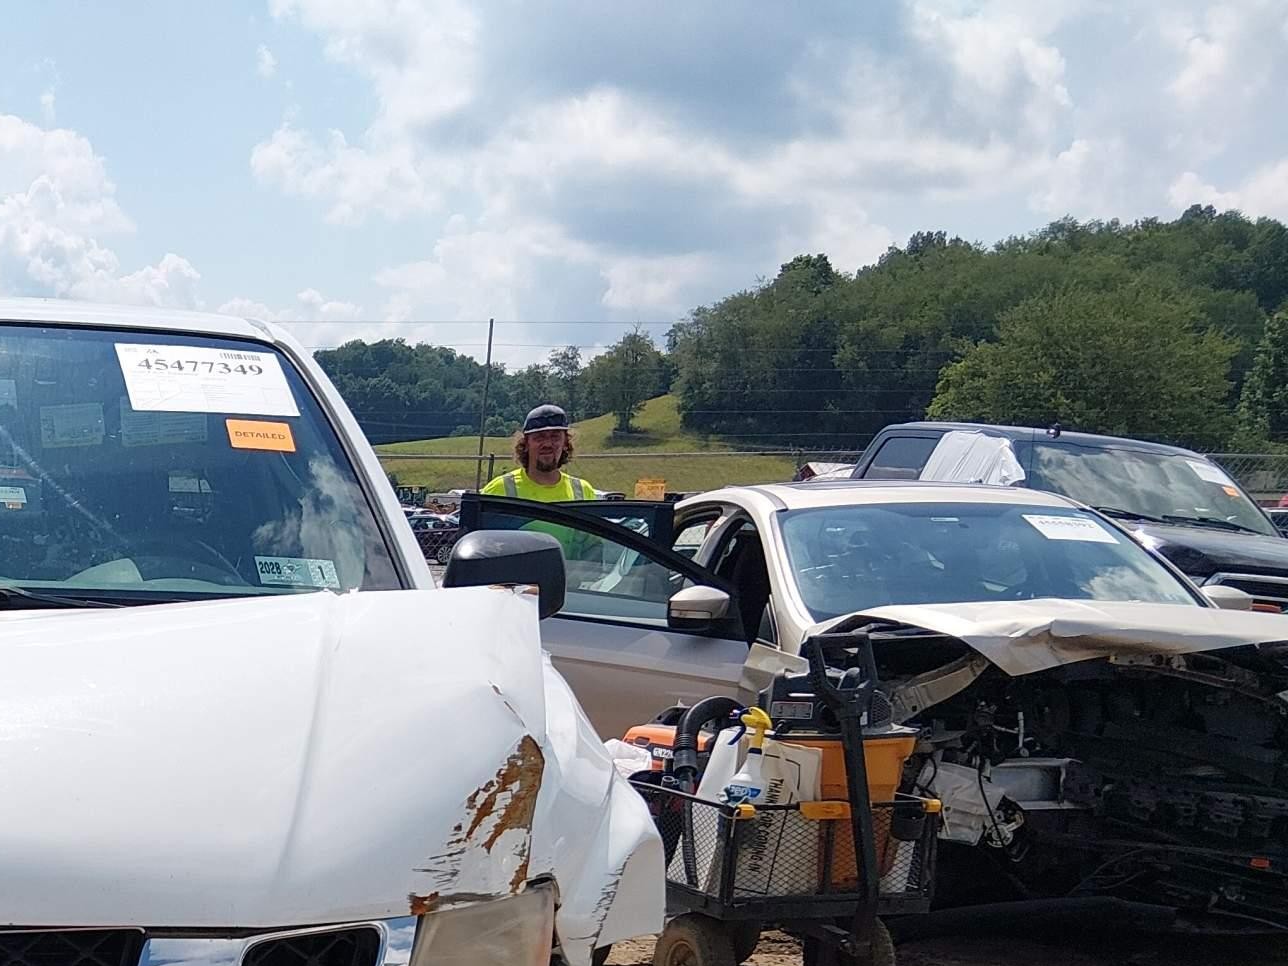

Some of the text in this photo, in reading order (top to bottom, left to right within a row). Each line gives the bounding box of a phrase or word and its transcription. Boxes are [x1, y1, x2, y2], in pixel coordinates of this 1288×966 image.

[137, 357, 264, 376] 45477349
[234, 430, 286, 440] DETAILED
[258, 561, 282, 575] 2028
[751, 829, 769, 861] COMING
